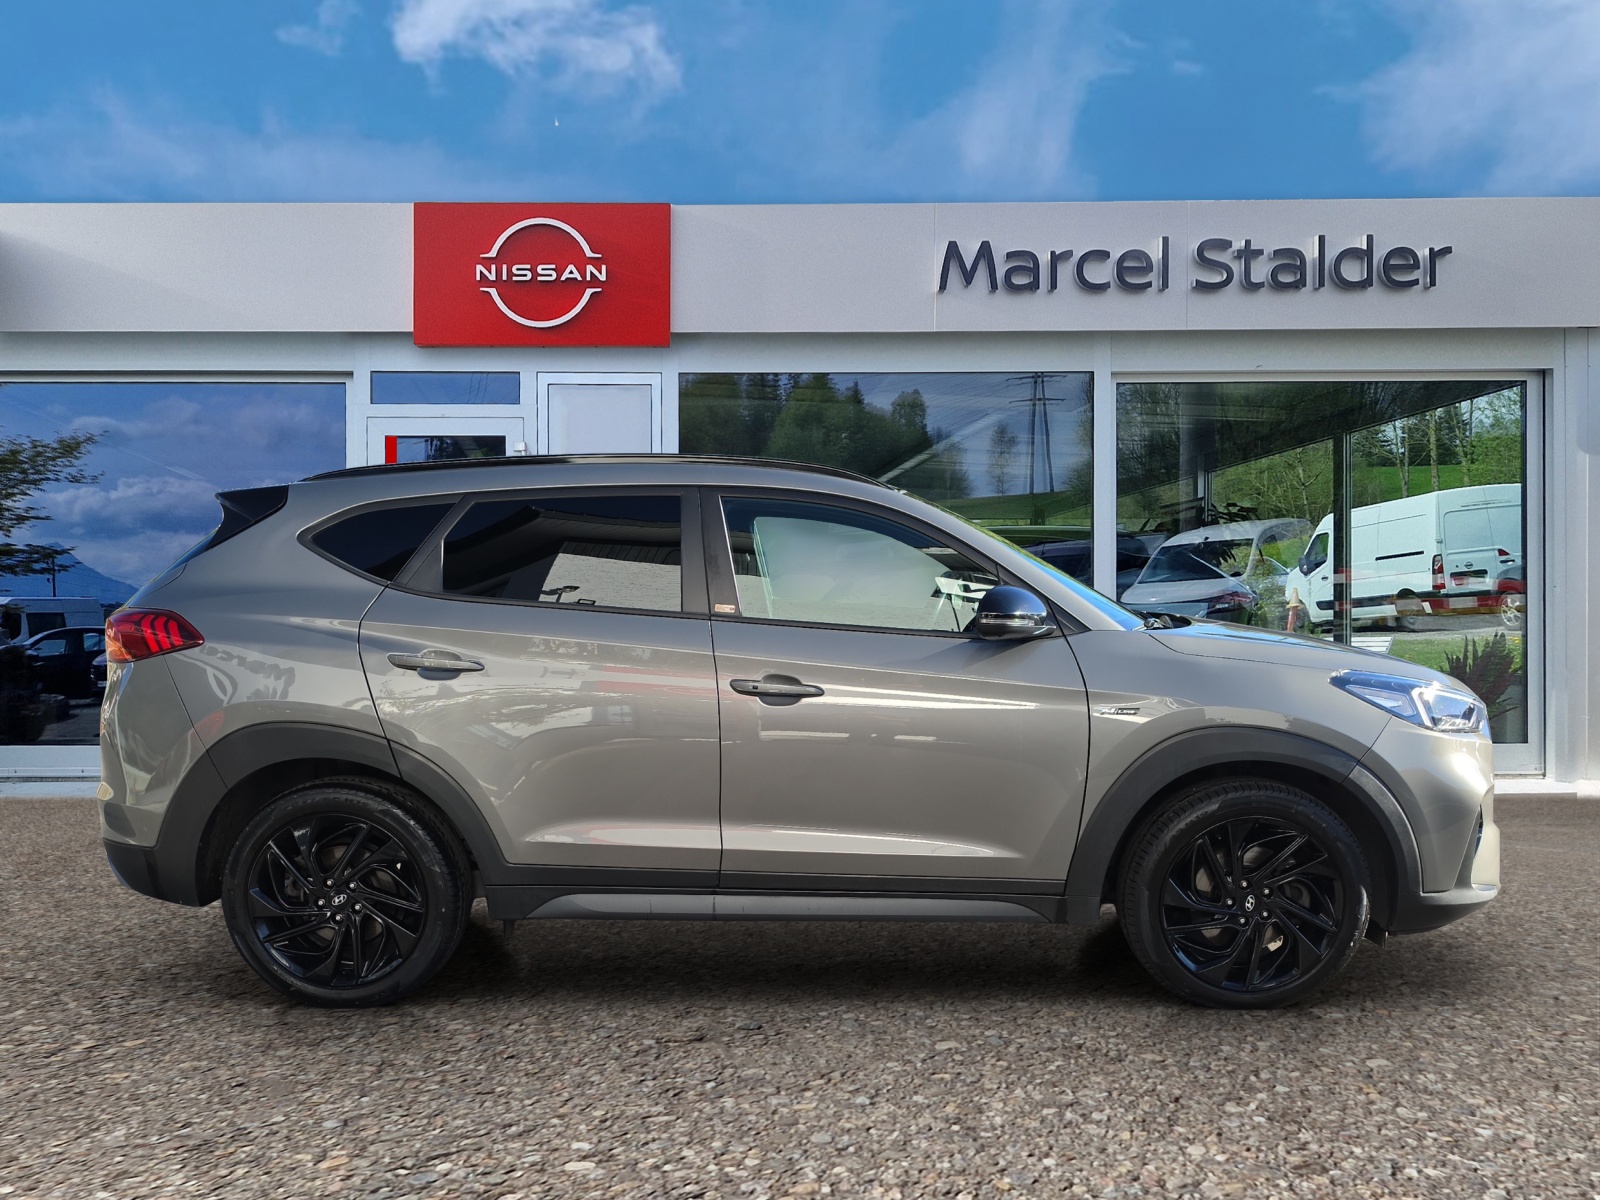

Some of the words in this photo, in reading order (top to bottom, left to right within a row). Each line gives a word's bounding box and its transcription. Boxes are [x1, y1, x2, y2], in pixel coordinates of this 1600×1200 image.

[476, 264, 606, 281] NISSAN
[938, 236, 1170, 292] Marcel
[1191, 234, 1452, 290] Stalder
